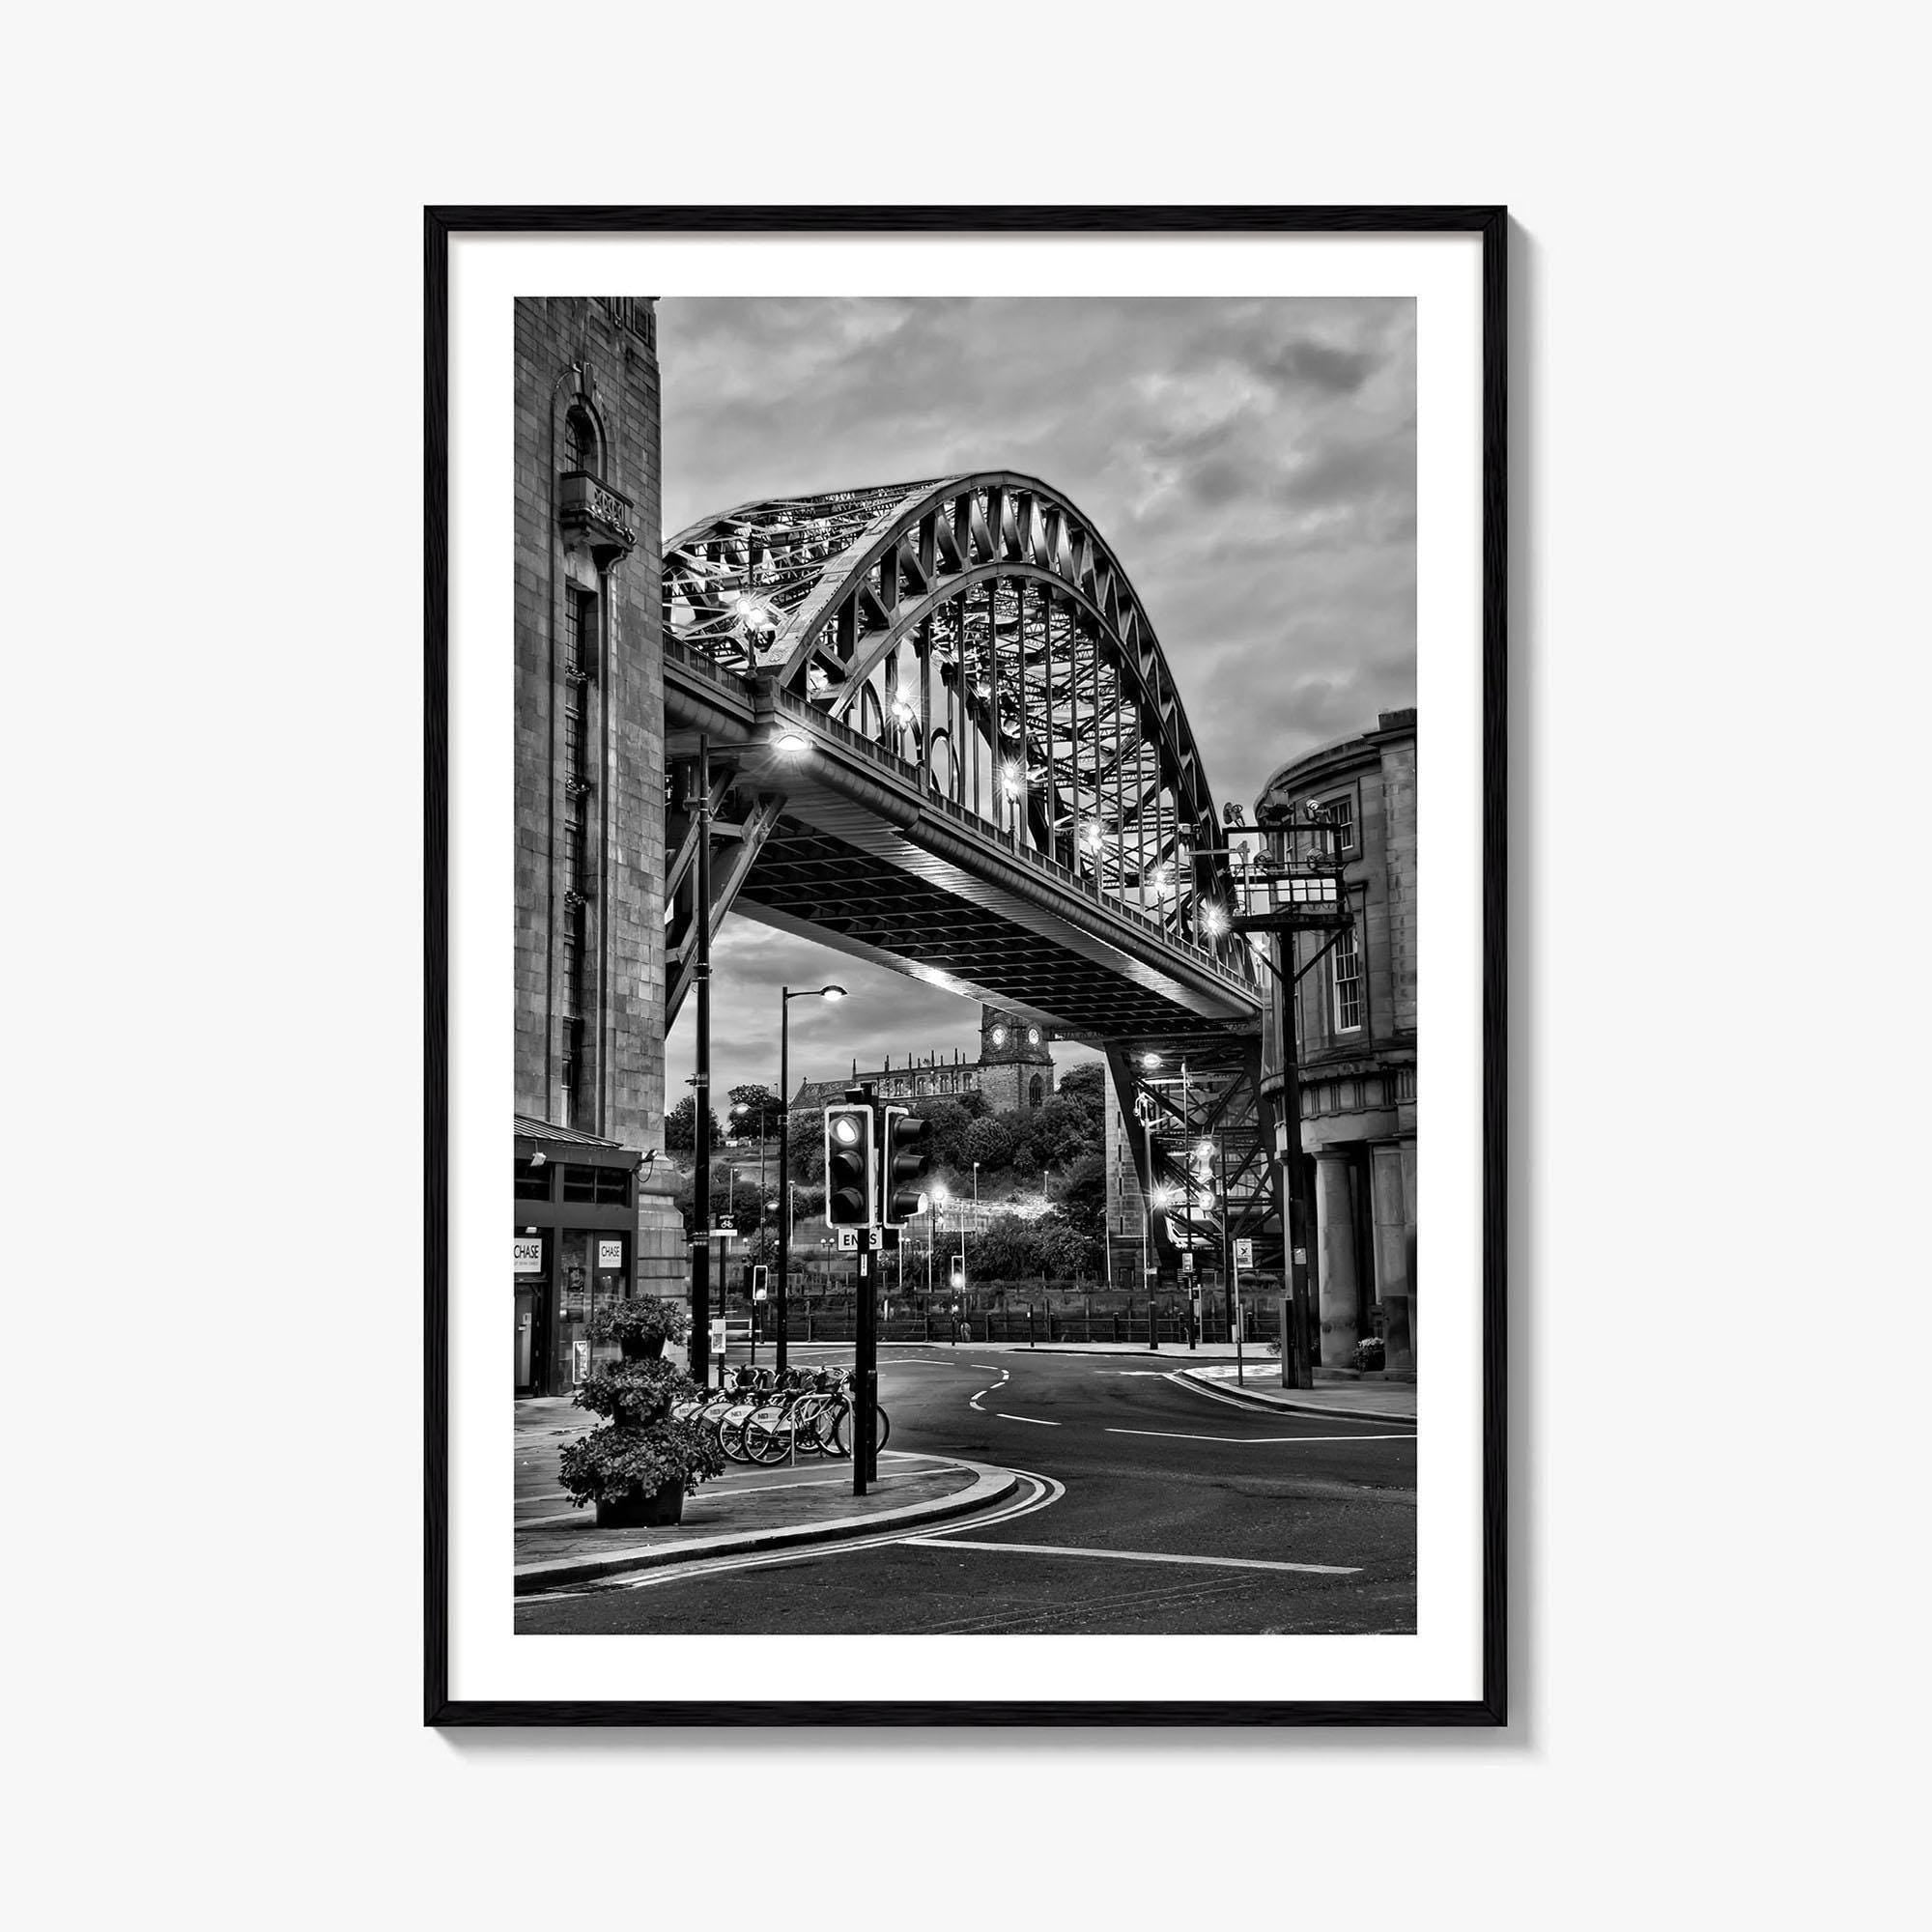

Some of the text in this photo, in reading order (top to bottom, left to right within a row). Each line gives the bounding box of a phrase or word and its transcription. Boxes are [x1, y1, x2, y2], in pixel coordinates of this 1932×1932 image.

[843, 1233, 877, 1246] ENS
[514, 1244, 539, 1259] CHASE
[601, 1245, 620, 1258] CHASE
